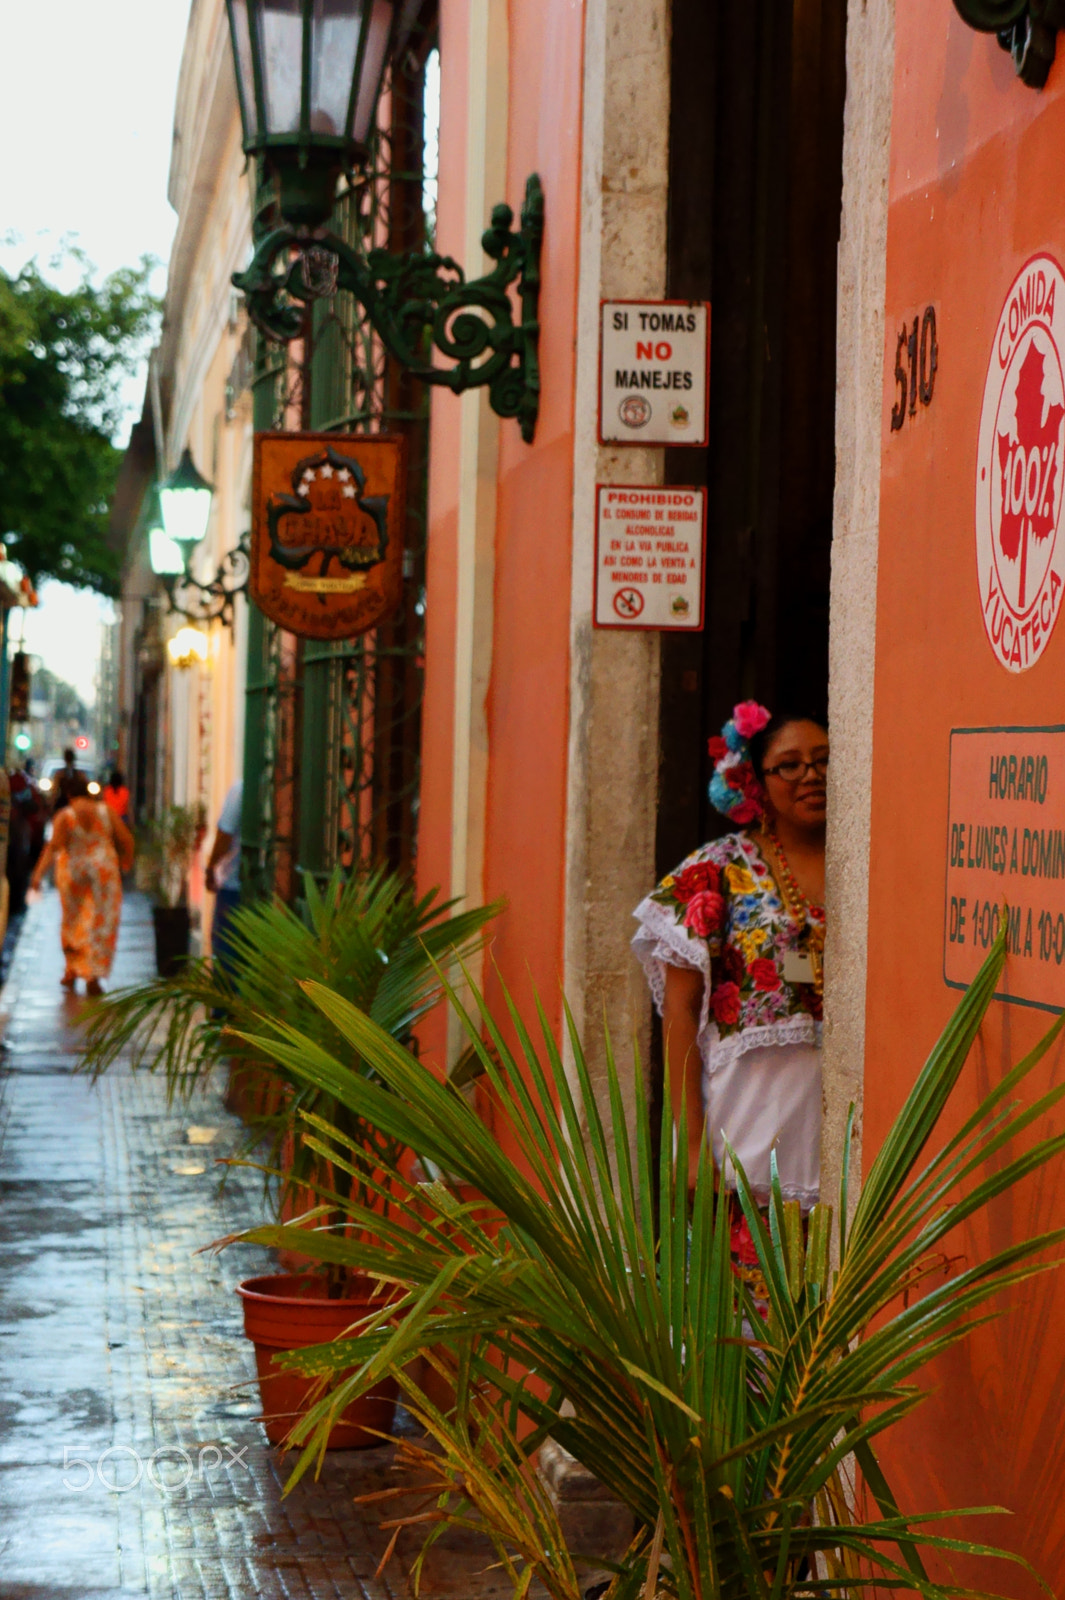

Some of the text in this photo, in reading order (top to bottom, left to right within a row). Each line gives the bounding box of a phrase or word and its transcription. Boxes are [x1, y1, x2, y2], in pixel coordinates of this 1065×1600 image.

[613, 312, 697, 333] SI TOMAS
[998, 269, 1056, 371] COMIDA
[635, 340, 673, 361] NO
[891, 305, 938, 433] 510
[615, 370, 693, 390] MANEJES
[1003, 441, 1055, 518] 100%
[608, 492, 694, 507] PROHIBIDO
[603, 508, 698, 522] EL CONSUMO DE BEBIDAS
[625, 524, 675, 537] ALCOHOLICAS
[610, 540, 689, 554] EN LA VIA PUBLICA
[620, 555, 643, 568] COMO
[647, 557, 657, 568] LA
[661, 557, 686, 569] VENTA
[689, 557, 696, 569] A
[611, 571, 688, 585] MENORES DE EDAD
[985, 566, 1062, 668] YUCATECA
[989, 755, 1048, 804] HORARIO
[951, 823, 965, 868] DE
[968, 824, 1008, 875] LUNES
[1009, 827, 1018, 874] A
[950, 896, 966, 944] DE
